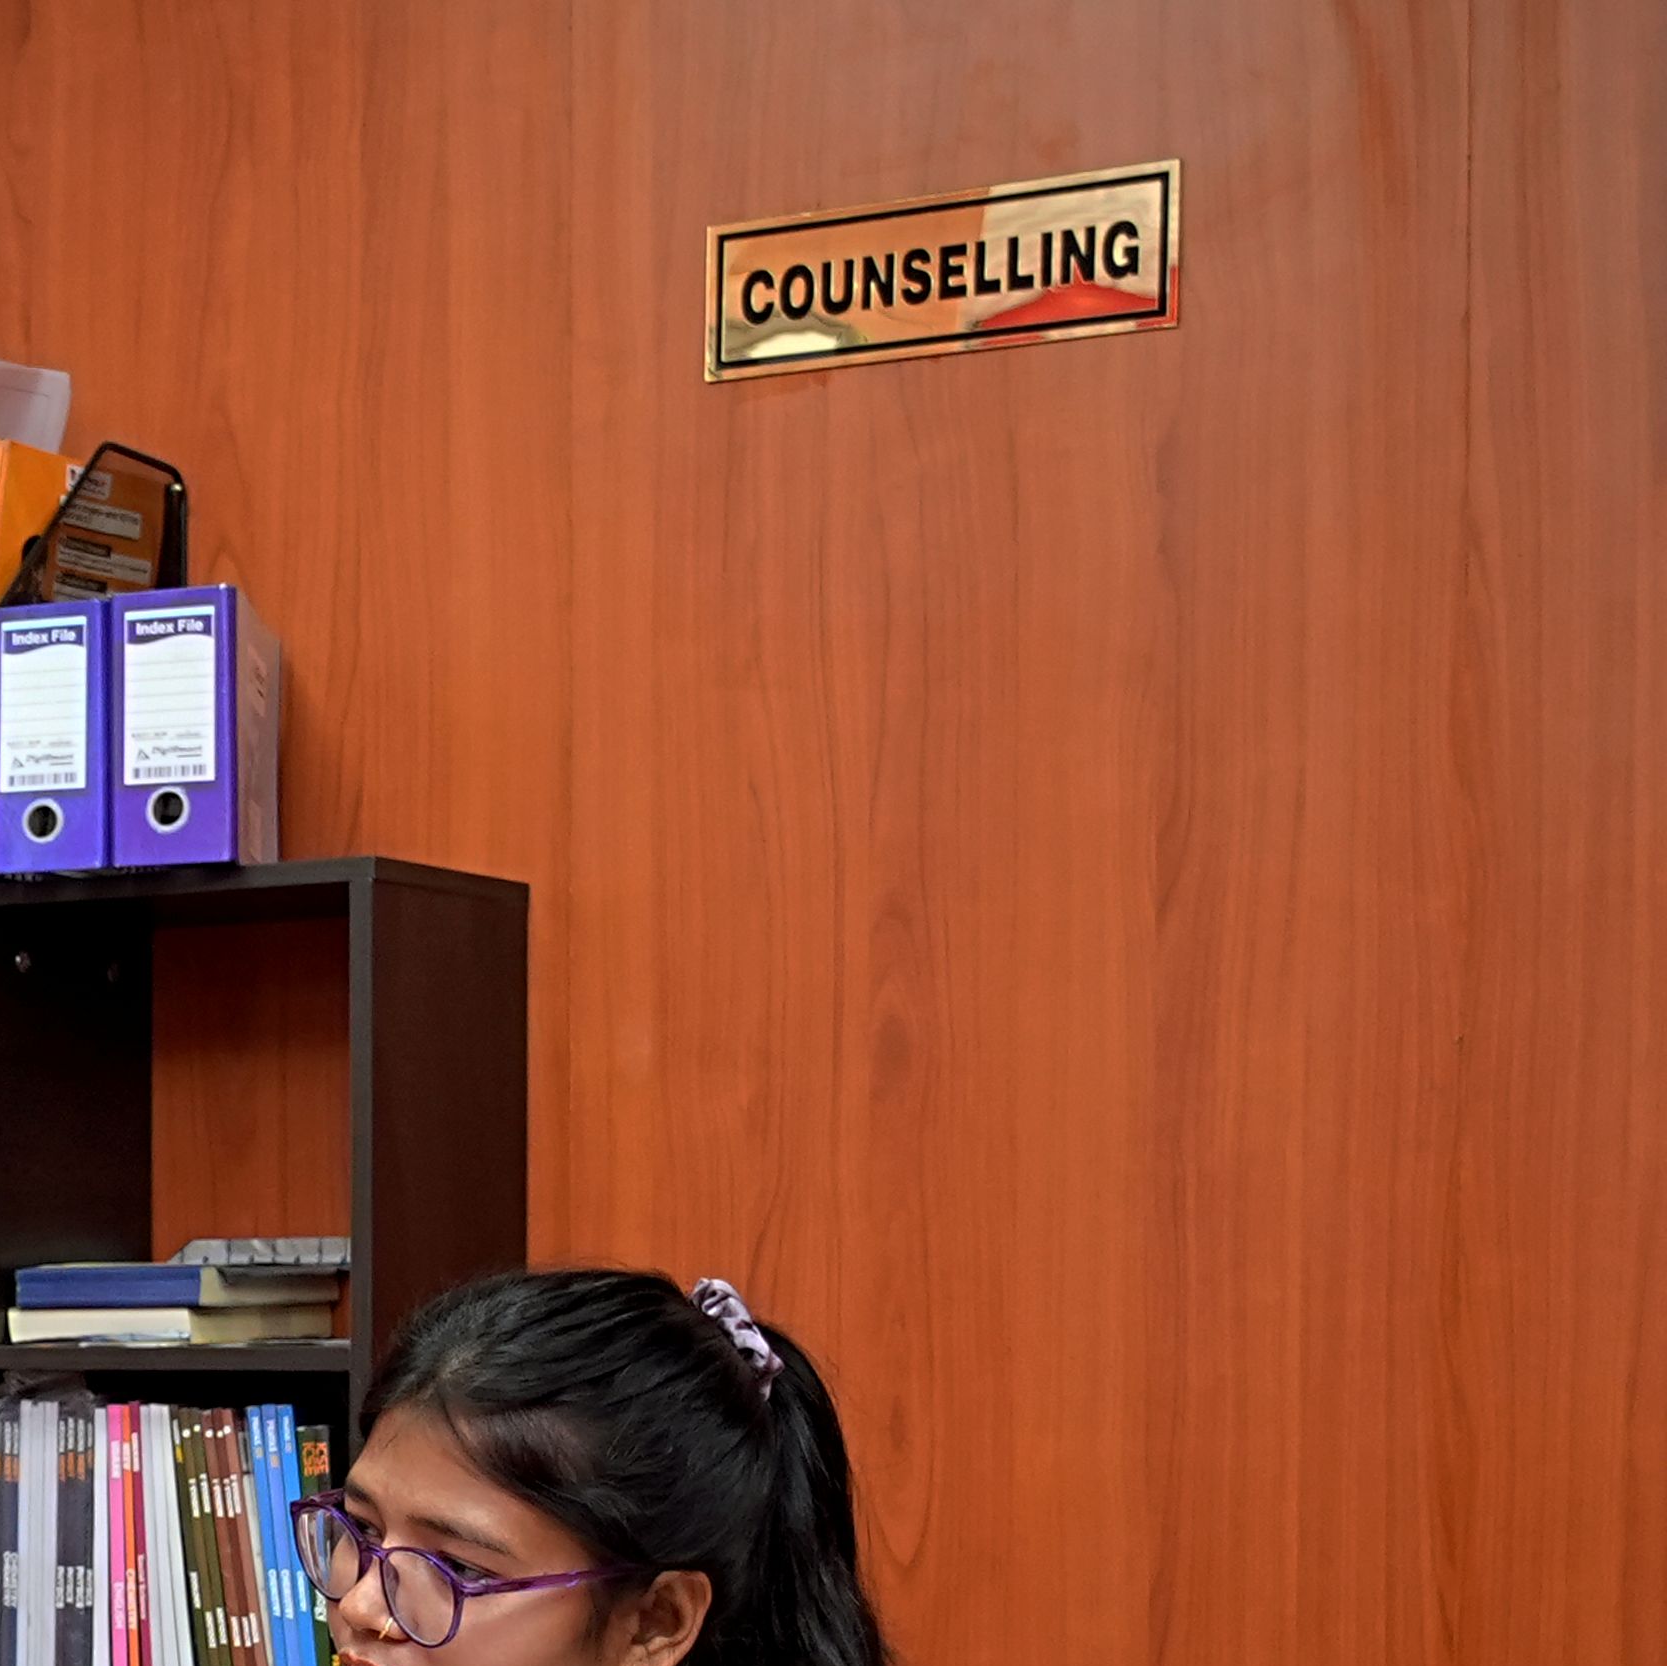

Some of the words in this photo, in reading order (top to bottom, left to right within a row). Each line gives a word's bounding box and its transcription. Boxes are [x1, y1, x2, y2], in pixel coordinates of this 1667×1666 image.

[741, 219, 1141, 326] COUNSELLING
[136, 621, 175, 636] Index
[178, 619, 205, 633] File
[12, 632, 48, 646] Index
[51, 629, 78, 643] File
